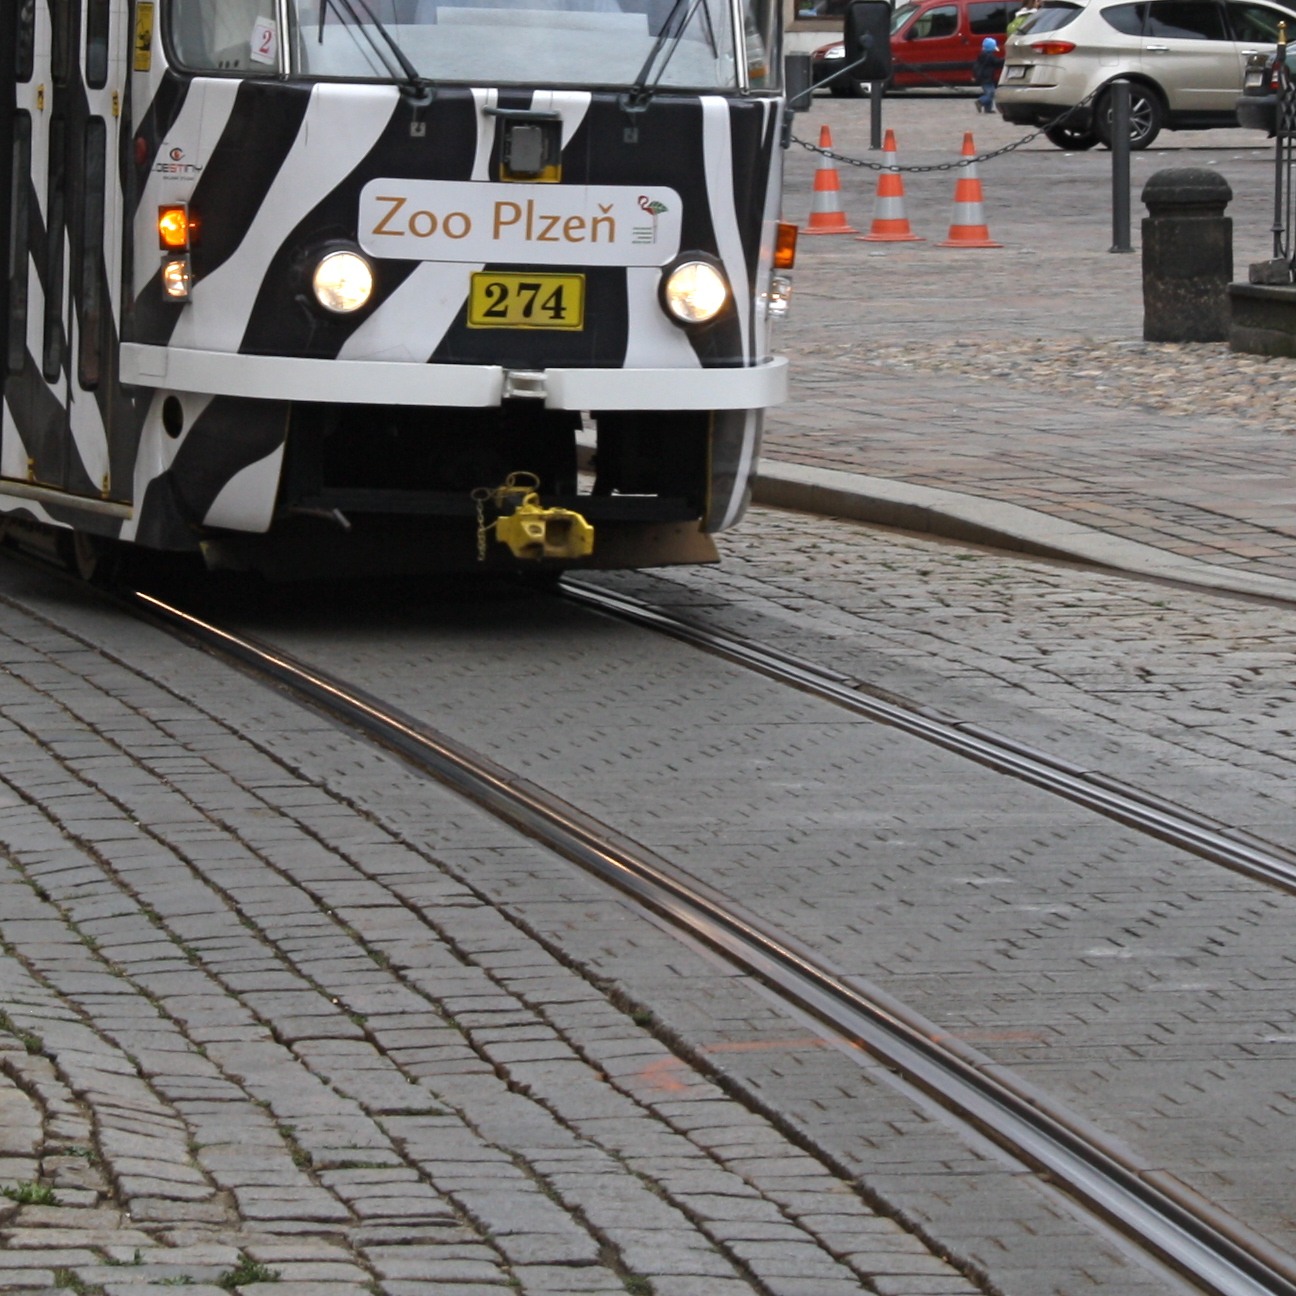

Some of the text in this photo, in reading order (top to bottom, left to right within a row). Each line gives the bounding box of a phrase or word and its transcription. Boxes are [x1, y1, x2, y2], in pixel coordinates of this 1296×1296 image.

[258, 29, 273, 55] 2
[371, 195, 616, 243] Zoo Plzeň
[482, 281, 567, 320] 274
